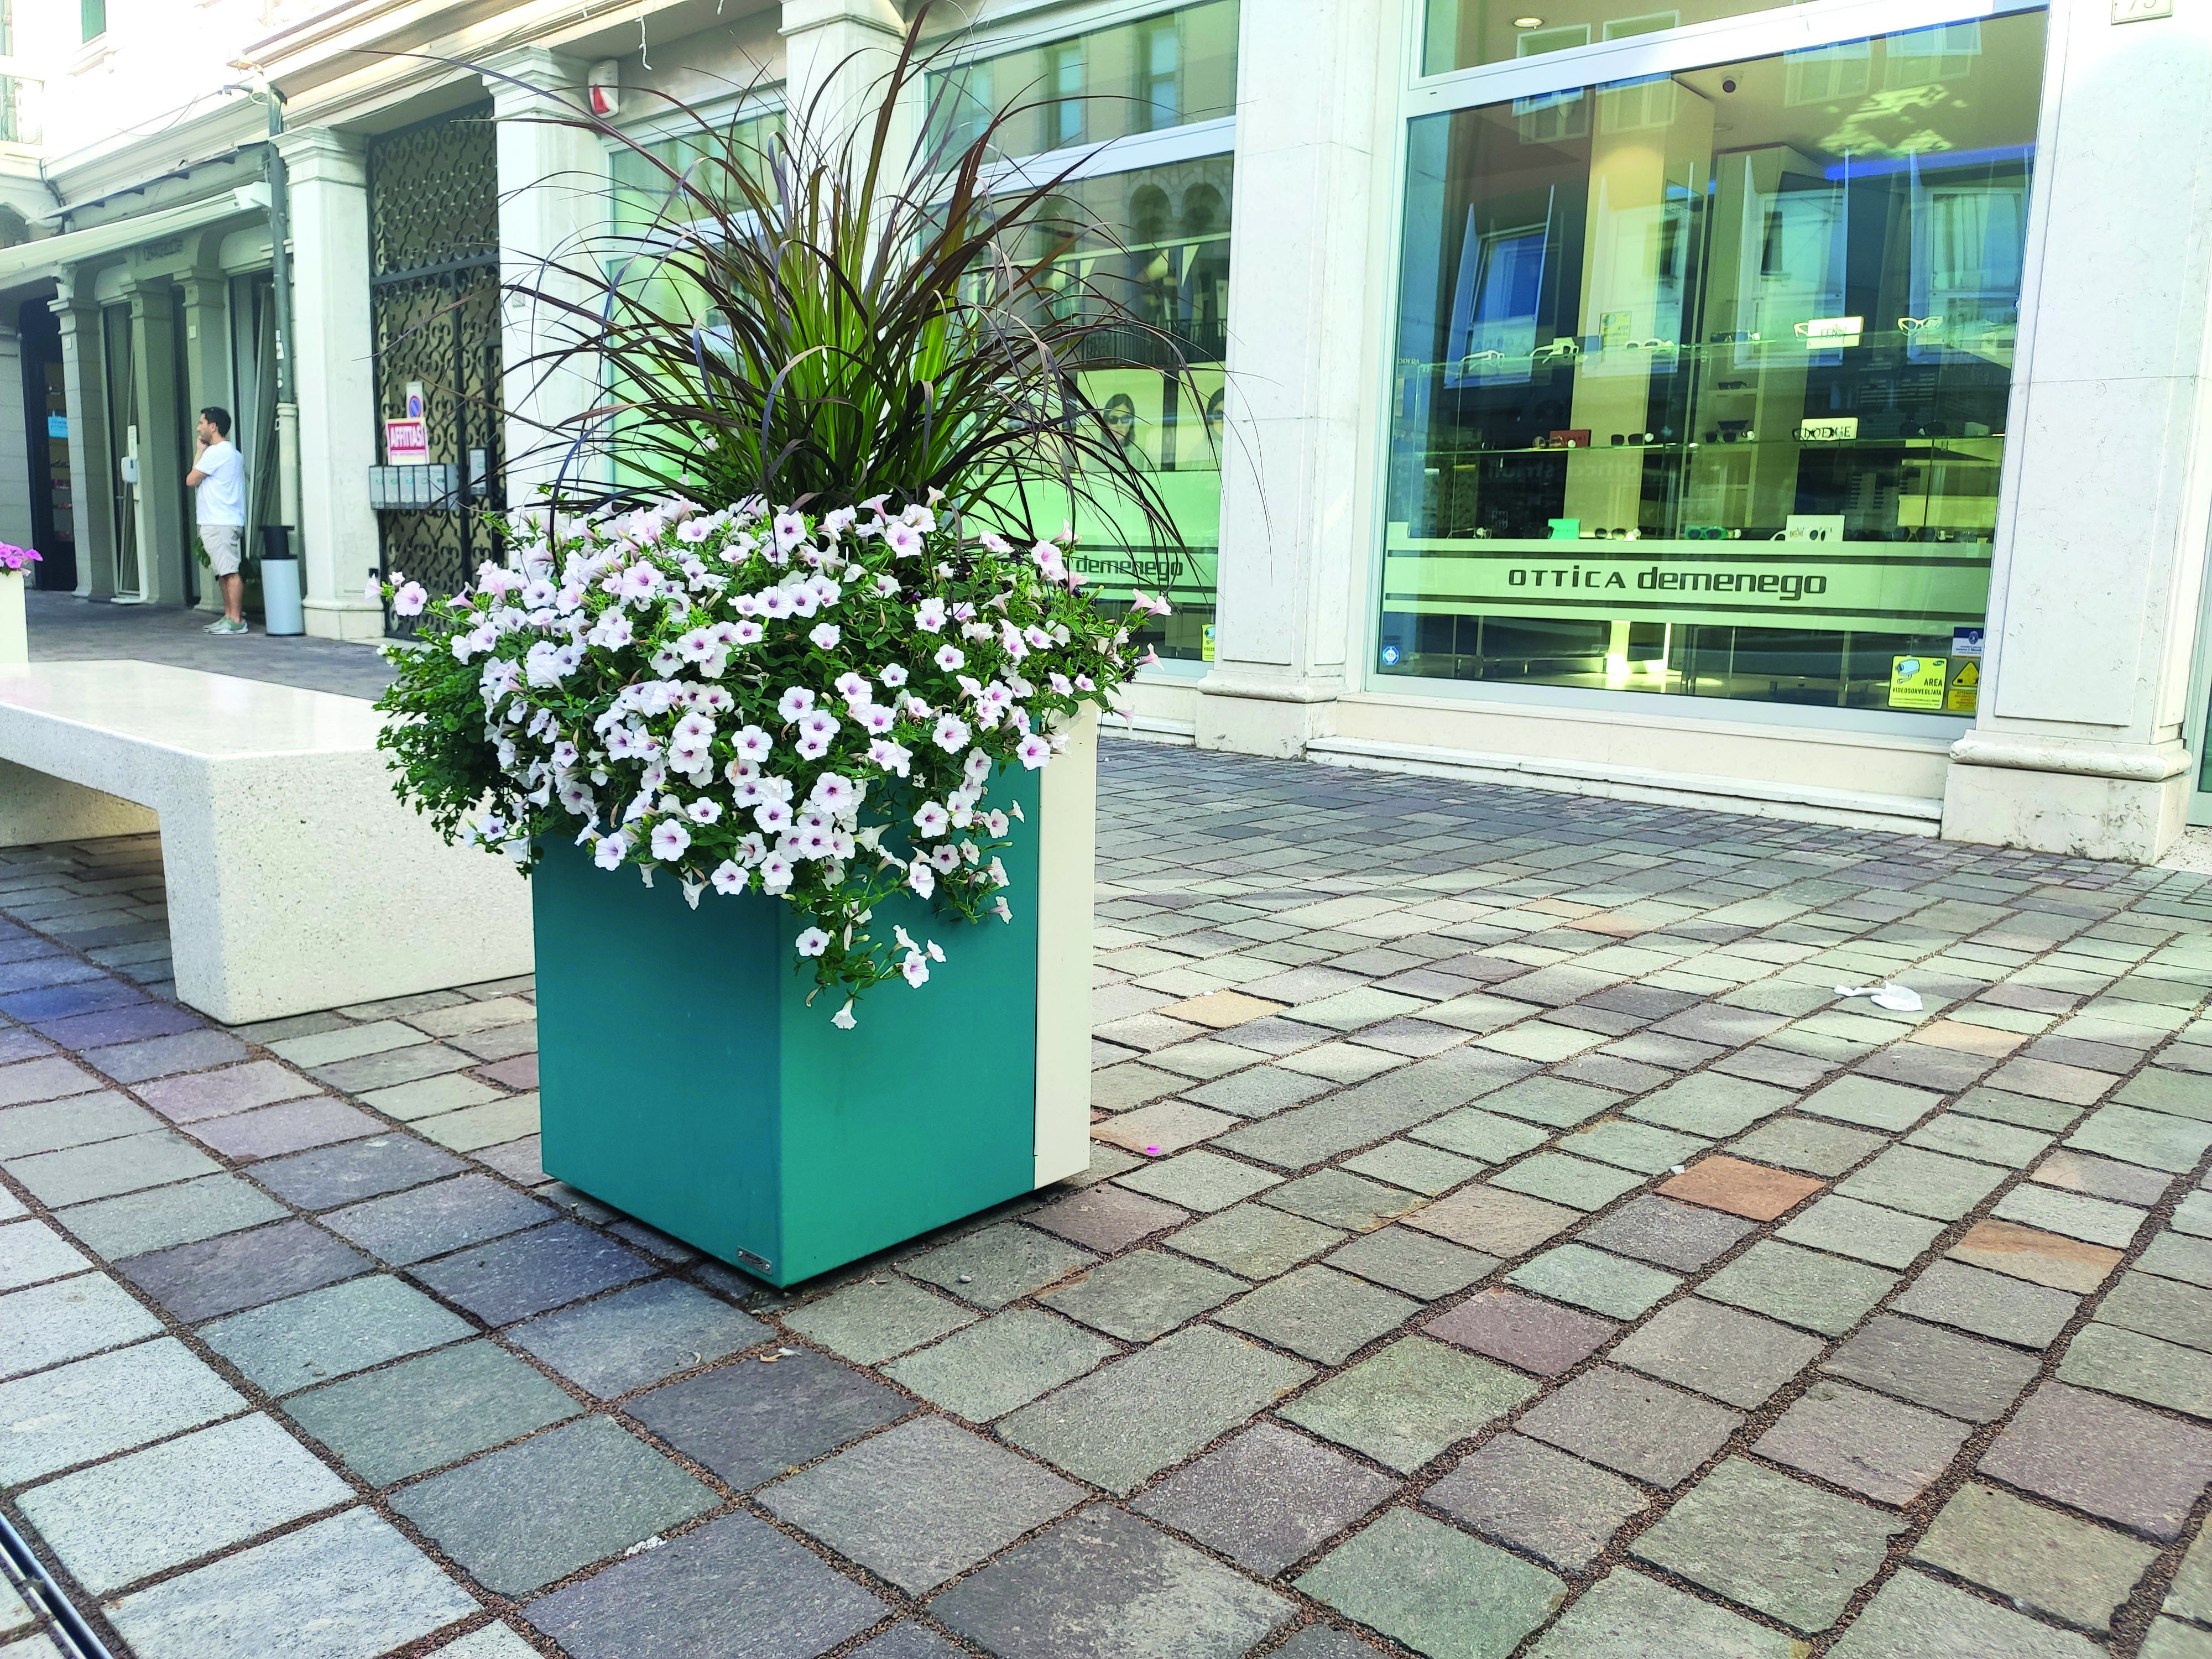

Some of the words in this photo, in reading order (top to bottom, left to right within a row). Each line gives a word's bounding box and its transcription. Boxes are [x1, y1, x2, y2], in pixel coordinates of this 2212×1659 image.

[1076, 555, 1183, 581] demenego
[1637, 566, 1827, 601] demenego
[1923, 677, 1943, 687] AREA
[1892, 687, 1942, 696] VIDEOSORVEGLIATA
